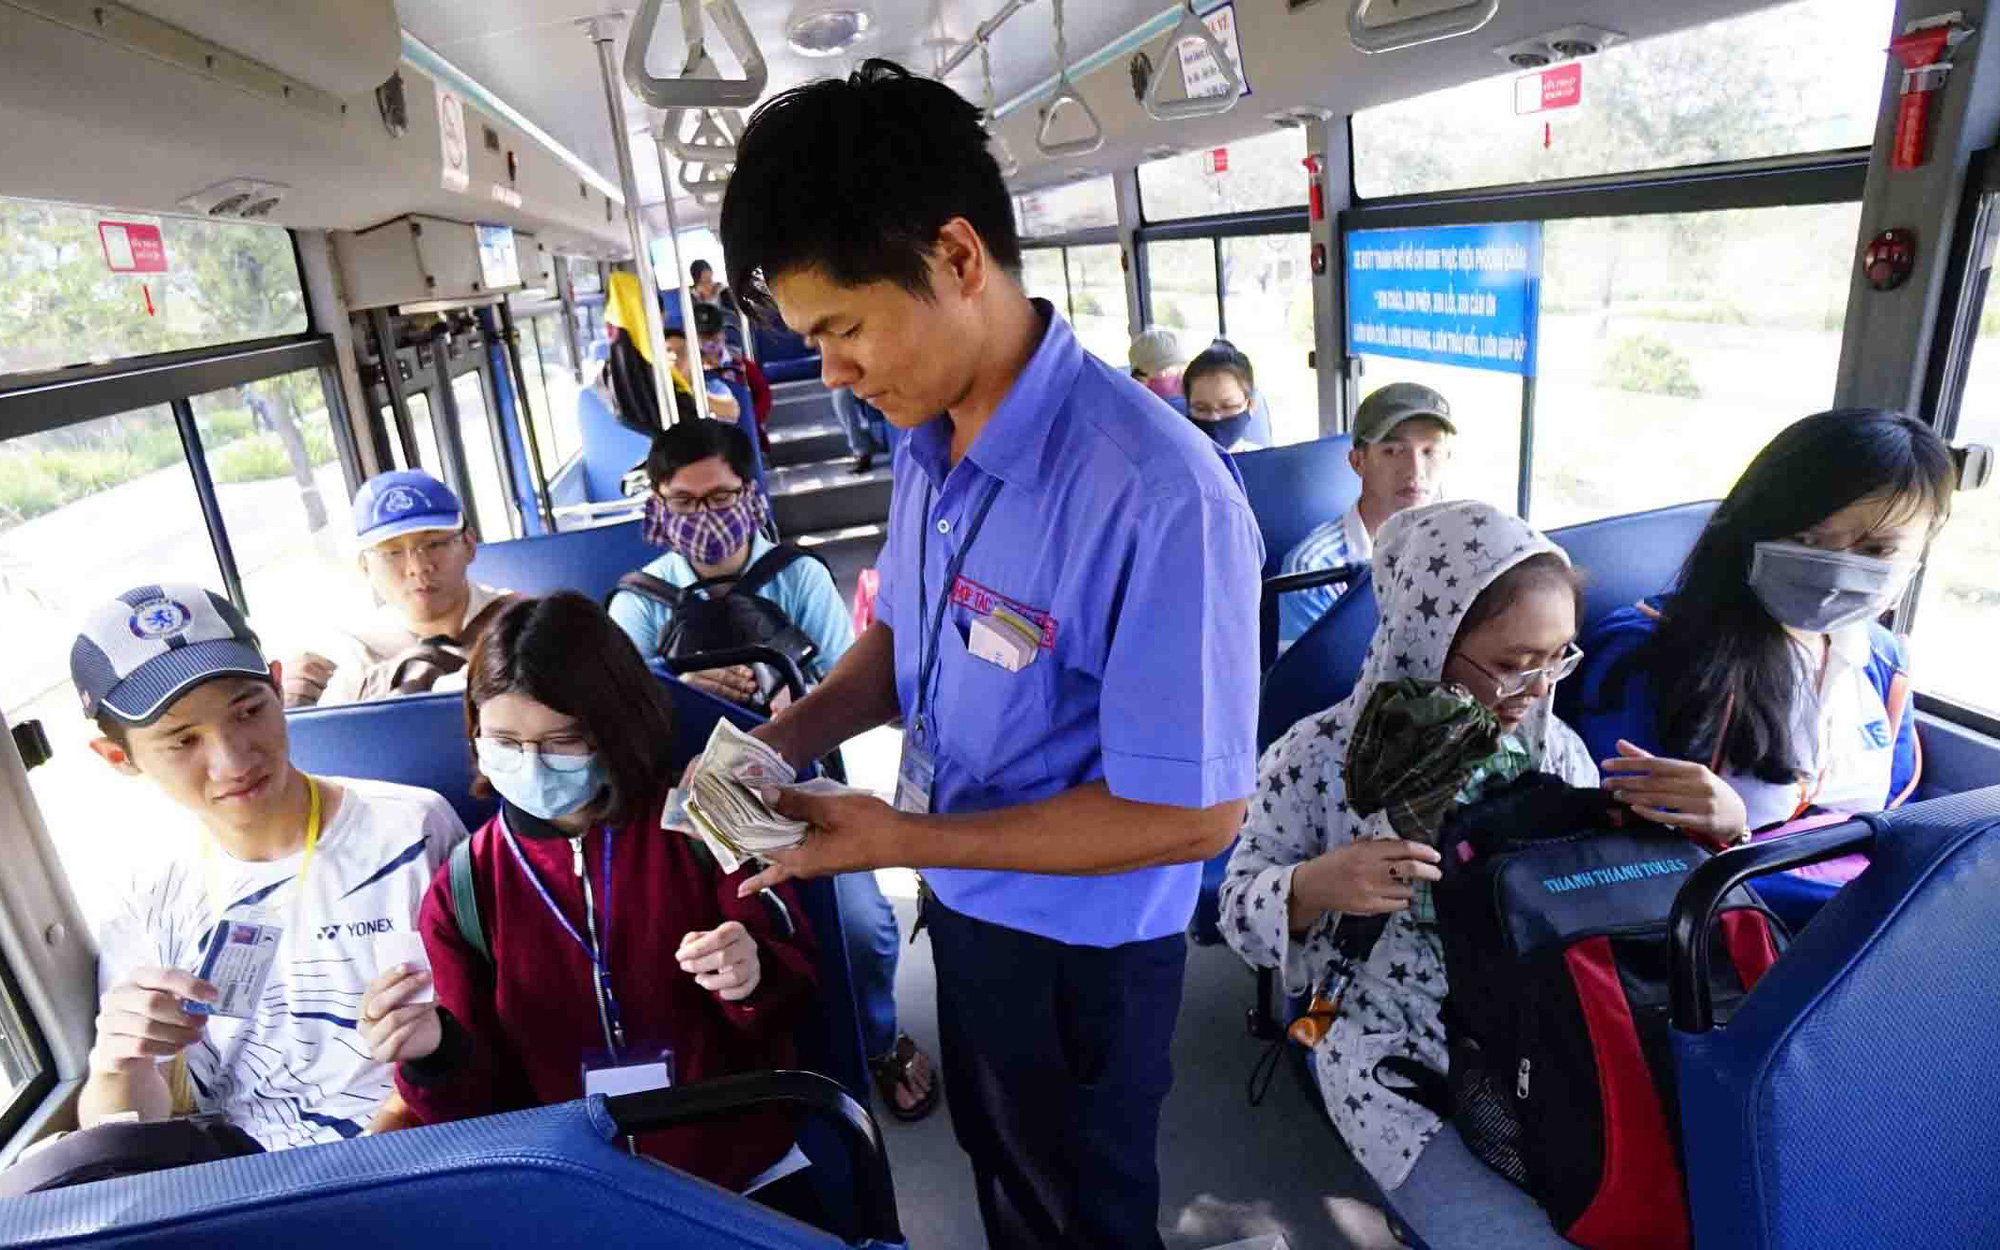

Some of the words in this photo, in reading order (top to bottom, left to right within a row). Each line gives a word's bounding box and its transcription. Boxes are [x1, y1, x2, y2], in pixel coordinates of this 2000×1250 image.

[1544, 872, 1595, 894] THANH
[1593, 864, 1643, 884] THANH
[1640, 858, 1689, 877] TOURS
[346, 918, 394, 937] YONEX
